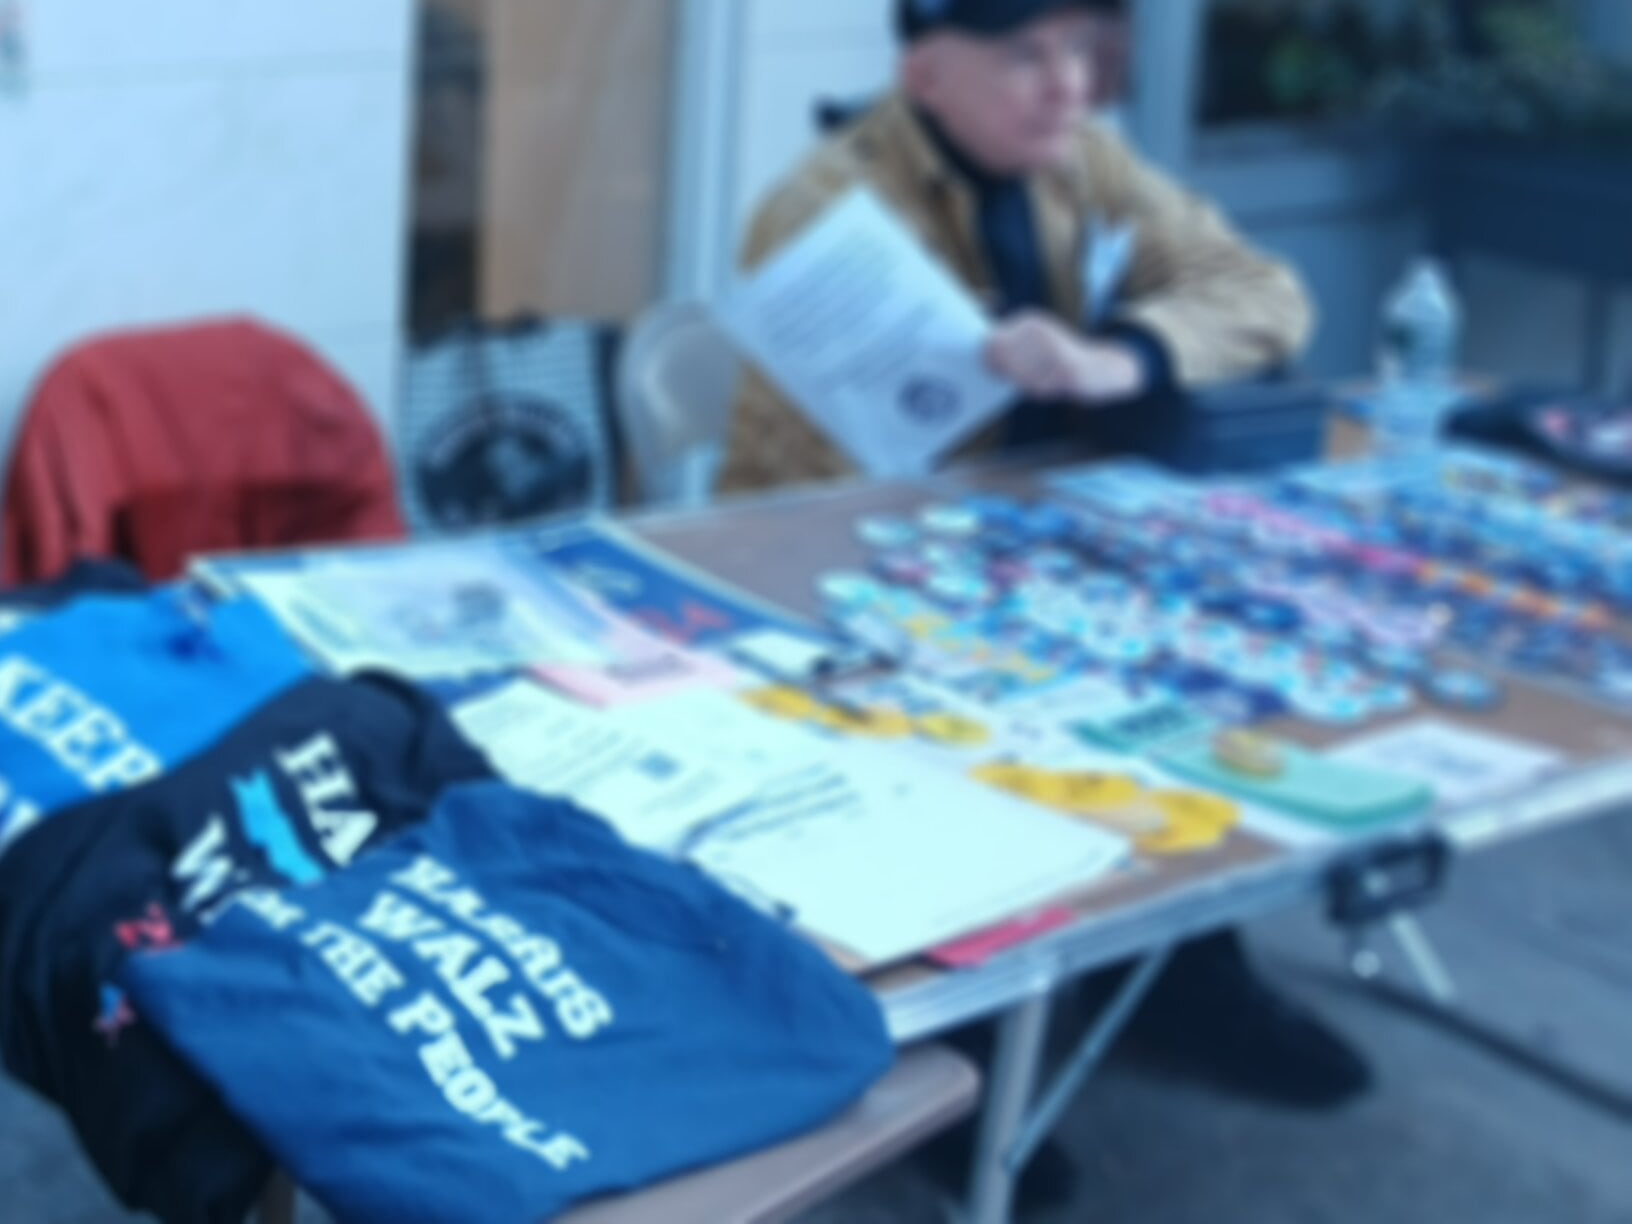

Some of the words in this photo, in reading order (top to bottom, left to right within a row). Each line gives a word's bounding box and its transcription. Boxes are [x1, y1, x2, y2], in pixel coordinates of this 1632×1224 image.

[357, 891, 546, 1060] WALZ
[387, 856, 615, 1039] HARRIS
[300, 922, 406, 1007] THE
[387, 991, 591, 1171] PEOPLE
